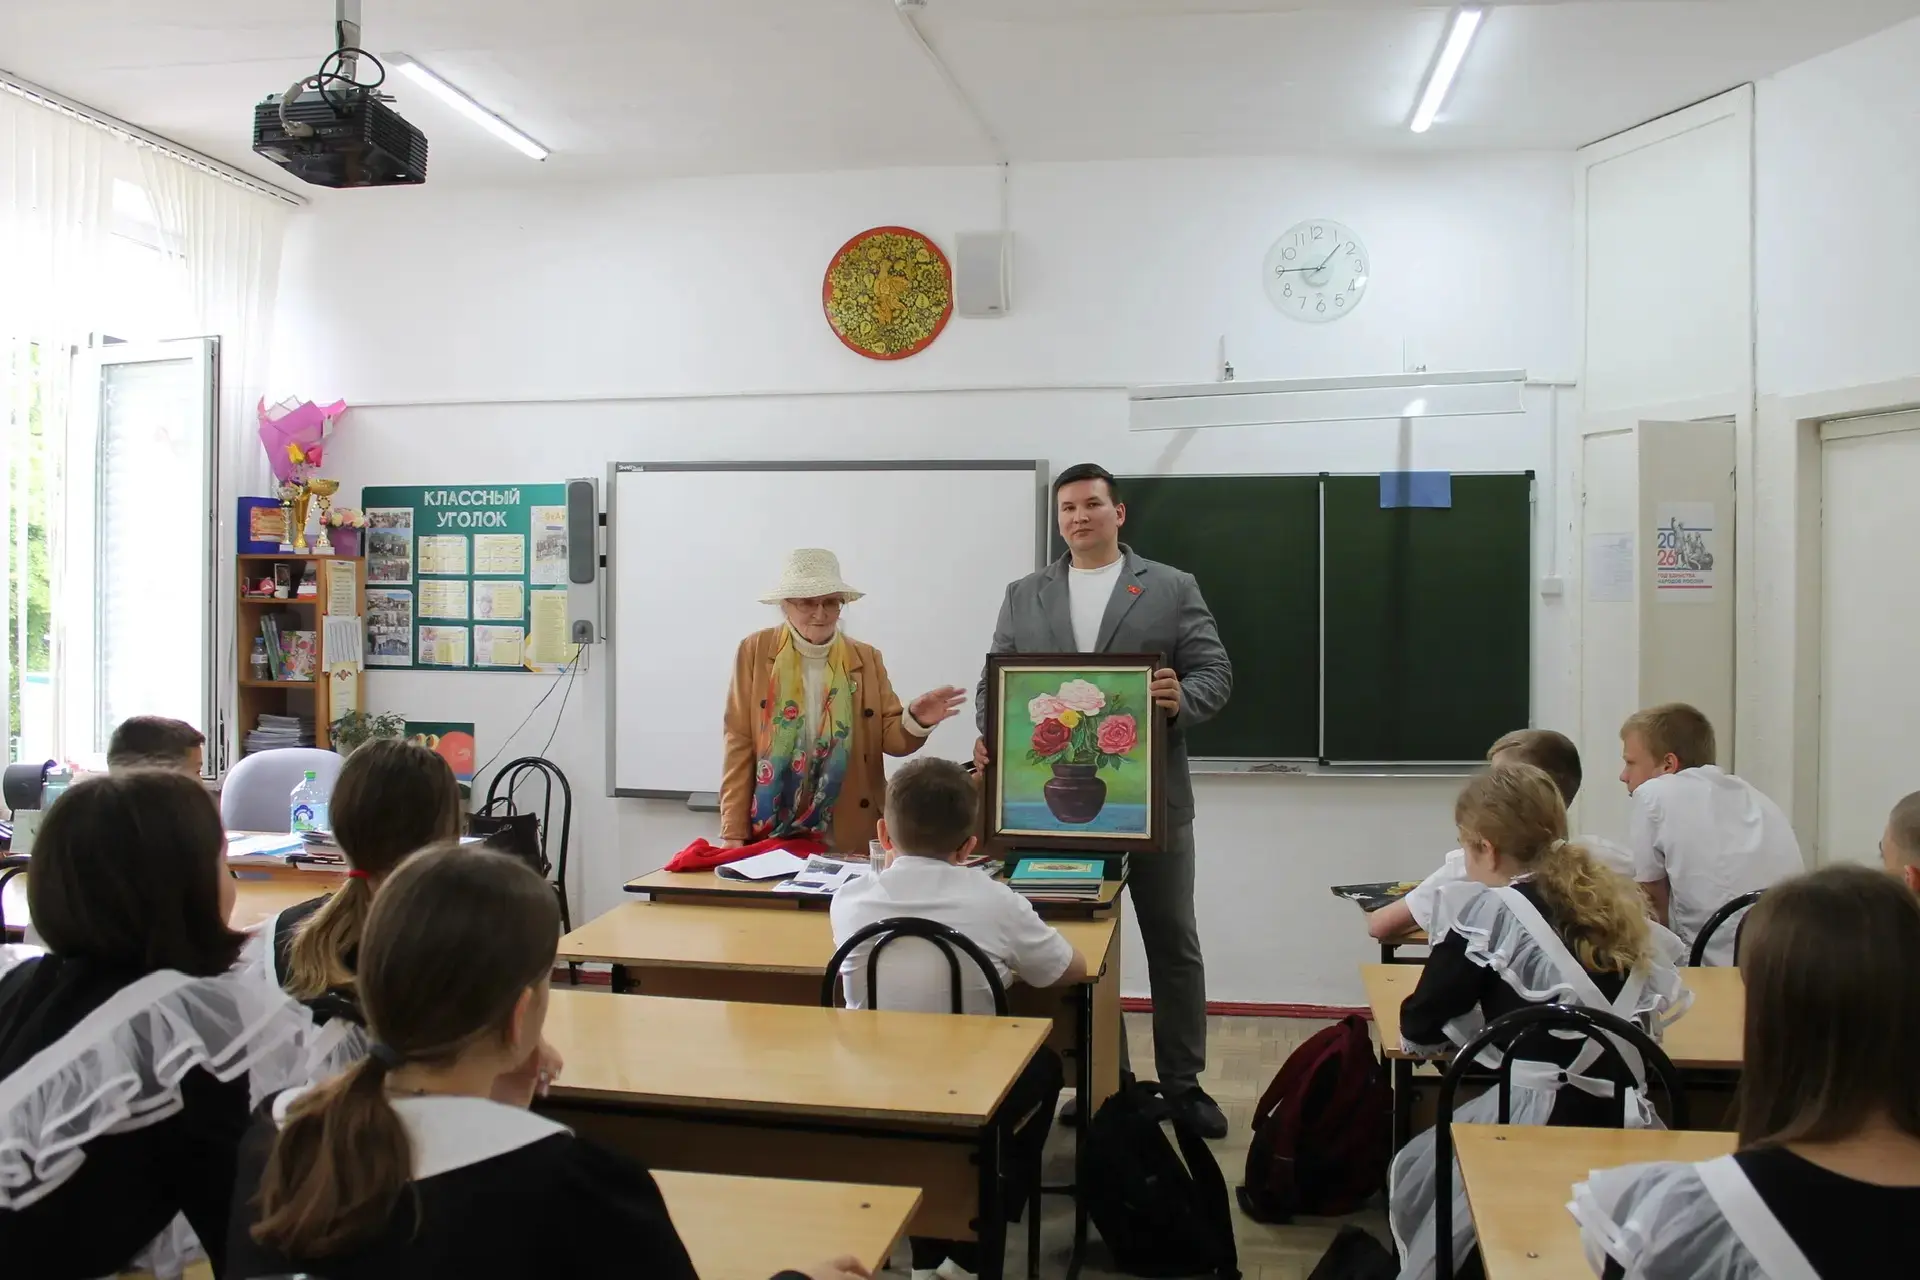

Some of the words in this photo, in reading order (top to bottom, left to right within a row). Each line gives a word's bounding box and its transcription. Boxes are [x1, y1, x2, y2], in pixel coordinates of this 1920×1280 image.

[1295, 233, 1305, 246] 11
[1310, 226, 1323, 240] 12
[1281, 247, 1297, 260] 10
[1345, 241, 1356, 255] 2
[1275, 265, 1285, 280] 9
[1354, 259, 1363, 273] 3
[1283, 283, 1292, 298] 8
[1347, 279, 1356, 291] 4
[1298, 296, 1307, 309] 7
[1316, 299, 1326, 313] 6
[1335, 293, 1344, 307] 5
[424, 487, 520, 506] КЛАССНЫЙ
[436, 511, 507, 528] УГОЛОК
[1657, 532, 1676, 549] 20
[1657, 549, 1676, 566] 26
